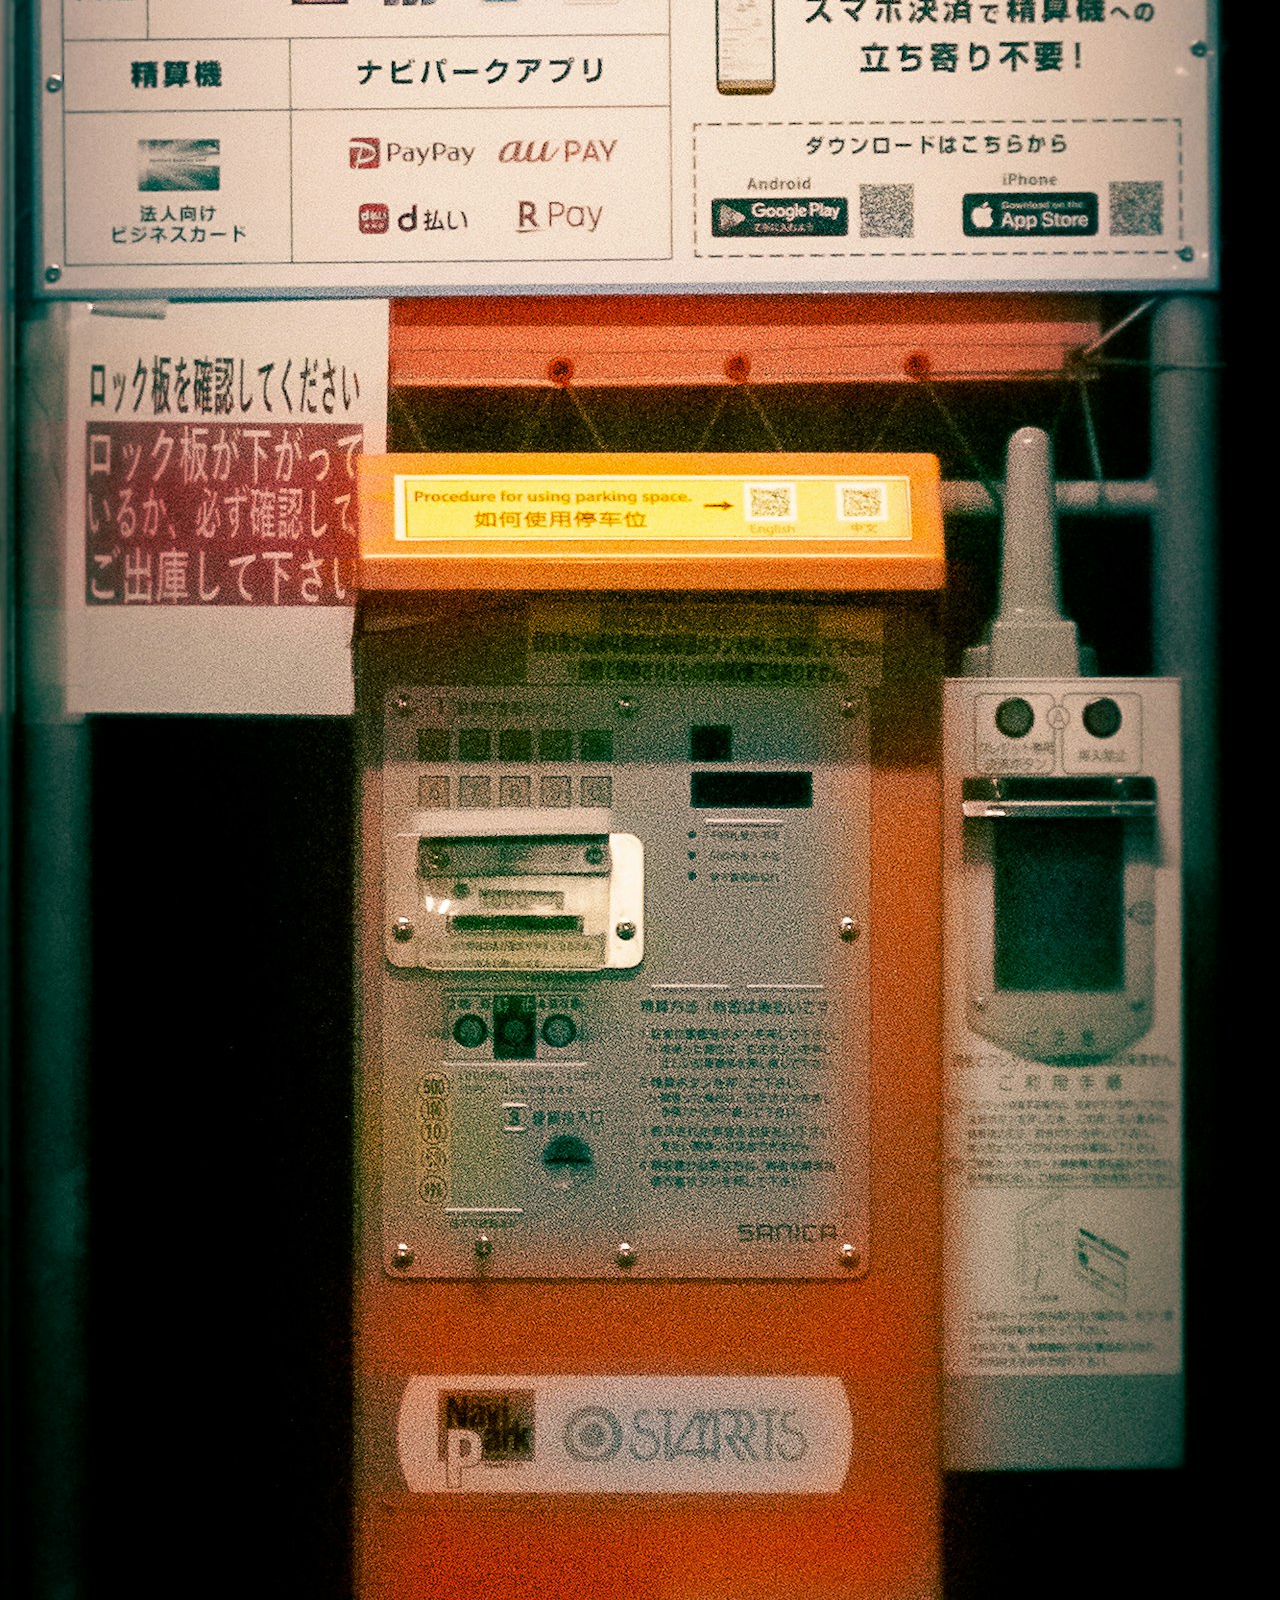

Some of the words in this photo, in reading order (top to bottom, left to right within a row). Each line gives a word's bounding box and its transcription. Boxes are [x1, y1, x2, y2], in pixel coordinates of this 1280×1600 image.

[860, 40, 1083, 74] 立ち寄り不要！
[130, 59, 223, 89] 精算機
[357, 57, 606, 86] ナビパークアプリ
[387, 142, 475, 166] PayPay
[498, 140, 560, 163] au
[564, 139, 619, 162] PAY
[806, 135, 1068, 156] ダウンロードはこちらから
[747, 177, 812, 190] Android
[1002, 173, 1058, 186] iPhone
[139, 205, 217, 223] 法人向け
[751, 202, 807, 222] Google
[809, 202, 841, 221] Play
[1001, 201, 1050, 210] Download
[547, 201, 604, 232] Pay
[1000, 211, 1039, 230] App
[1040, 211, 1090, 229] Store
[111, 226, 248, 245] ビジネスカード
[90, 354, 361, 416] ロック板を確認してください
[89, 427, 363, 484] ロック板が下がって
[414, 490, 497, 503] Procedure
[500, 489, 523, 503] for
[526, 490, 571, 505] using
[575, 490, 638, 505] parking
[641, 491, 693, 506] space.
[474, 510, 648, 529] 如何使用停车位
[849, 522, 878, 535] 中文
[749, 523, 796, 537] English
[737, 1222, 838, 1242] SANICA
